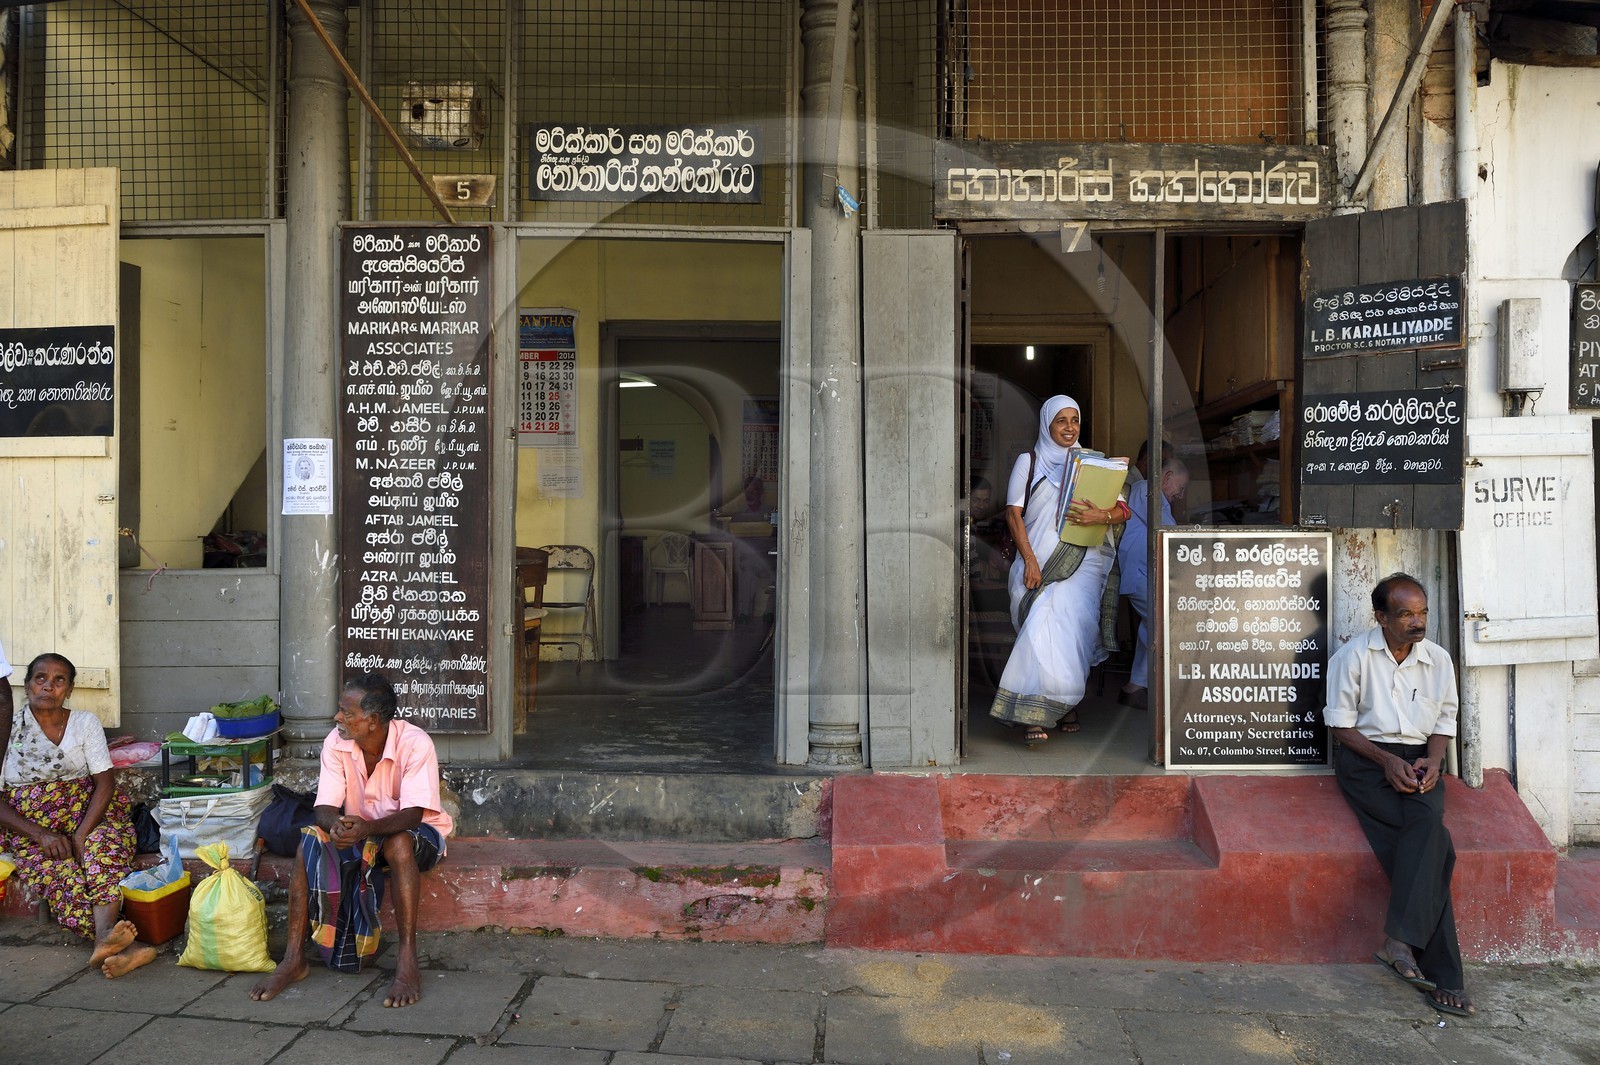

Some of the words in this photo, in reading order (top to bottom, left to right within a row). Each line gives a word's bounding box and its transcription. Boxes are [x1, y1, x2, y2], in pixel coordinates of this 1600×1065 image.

[536, 127, 624, 156] මරික්කාර්
[629, 134, 661, 155] සහ
[666, 129, 754, 157] මරික්කාර්
[537, 157, 639, 192] නොතාරිස්
[640, 158, 754, 193] කන්තෝරුව
[947, 157, 1113, 201] නොතාරිස්
[1129, 159, 1319, 204] කන්තෝරුව
[458, 182, 470, 200] 5
[353, 235, 404, 252] මරිකාර්
[426, 234, 480, 253] මරිකාර්
[1063, 221, 1087, 252] 7
[349, 276, 404, 296] மரிகார்
[425, 276, 479, 298] மரிகார்
[1365, 309, 1384, 317] සහ
[349, 321, 410, 335] MARIKAR
[409, 323, 418, 332] &
[421, 321, 479, 334] MARIKAR
[1341, 316, 1453, 341] KARALLIYADDE
[367, 342, 453, 355] ASSOCIATES
[1314, 341, 1351, 353] PROCTOR
[1374, 336, 1407, 346] NOTARY
[1409, 333, 1443, 343] PUBLIC
[559, 352, 574, 360] 2014
[524, 362, 529, 370] 8
[535, 362, 545, 370] 15
[549, 362, 560, 370] 22
[563, 362, 574, 370] 29
[524, 372, 529, 380] 9
[535, 372, 545, 380] 16
[549, 372, 560, 380] 23
[563, 372, 574, 380] 30
[521, 382, 531, 390] 10
[535, 382, 545, 390] 17
[549, 382, 560, 390] 24
[563, 382, 573, 390] 31
[17, 389, 36, 401] සහ
[521, 392, 530, 400] 11
[535, 392, 545, 400] 18
[549, 392, 560, 400] 25
[393, 403, 449, 414] JAMEEL
[454, 406, 486, 414] J.P.U.M.
[521, 402, 531, 410] 12
[535, 402, 545, 410] 19
[549, 402, 560, 410] 26
[521, 412, 531, 420] 13
[535, 412, 545, 420] 20
[549, 412, 560, 420] 27
[521, 422, 531, 430] 14
[535, 422, 545, 430] 21
[549, 422, 560, 430] 28
[443, 462, 476, 470] J.P.U.M.
[1306, 463, 1326, 474] අංක
[427, 472, 463, 491] ජමීල්
[423, 492, 459, 512] ஜமீல்
[365, 514, 403, 525] AFTAB
[407, 515, 458, 526] JAMEEL
[1494, 511, 1552, 527] OFFICE
[366, 529, 404, 546] අස්රා
[412, 528, 448, 549] ජමීල්
[363, 548, 415, 566] அஸ்ரா
[419, 548, 456, 568] ஜமீல்
[1177, 545, 1206, 566] එල්.
[1213, 542, 1229, 562] බී.
[1236, 543, 1319, 566] කරල්ලියද්ද
[360, 571, 398, 582] AZRA
[403, 572, 458, 583] JAMEEL
[1196, 617, 1238, 633] සමාගම්
[1243, 617, 1301, 635] ලේකම්වරු
[348, 627, 398, 640] PREETHI
[402, 629, 473, 641] EKANAYAKE
[1178, 663, 1205, 679] L.B.
[1210, 662, 1319, 679] KARALLIYADDE
[1202, 686, 1296, 702] ASSOCIATES
[421, 706, 476, 718] NOTARIES
[1184, 712, 1246, 725] Attorneys,
[1250, 712, 1300, 722] Notaries
[1304, 711, 1315, 722] &
[1186, 728, 1244, 742] Company
[1248, 728, 1313, 739] Secretaries
[1180, 747, 1195, 755] No.
[1198, 747, 1211, 756] 07,
[1213, 747, 1253, 755] Colombo
[1257, 747, 1285, 755] Street,
[1288, 747, 1319, 756] Kandy.
